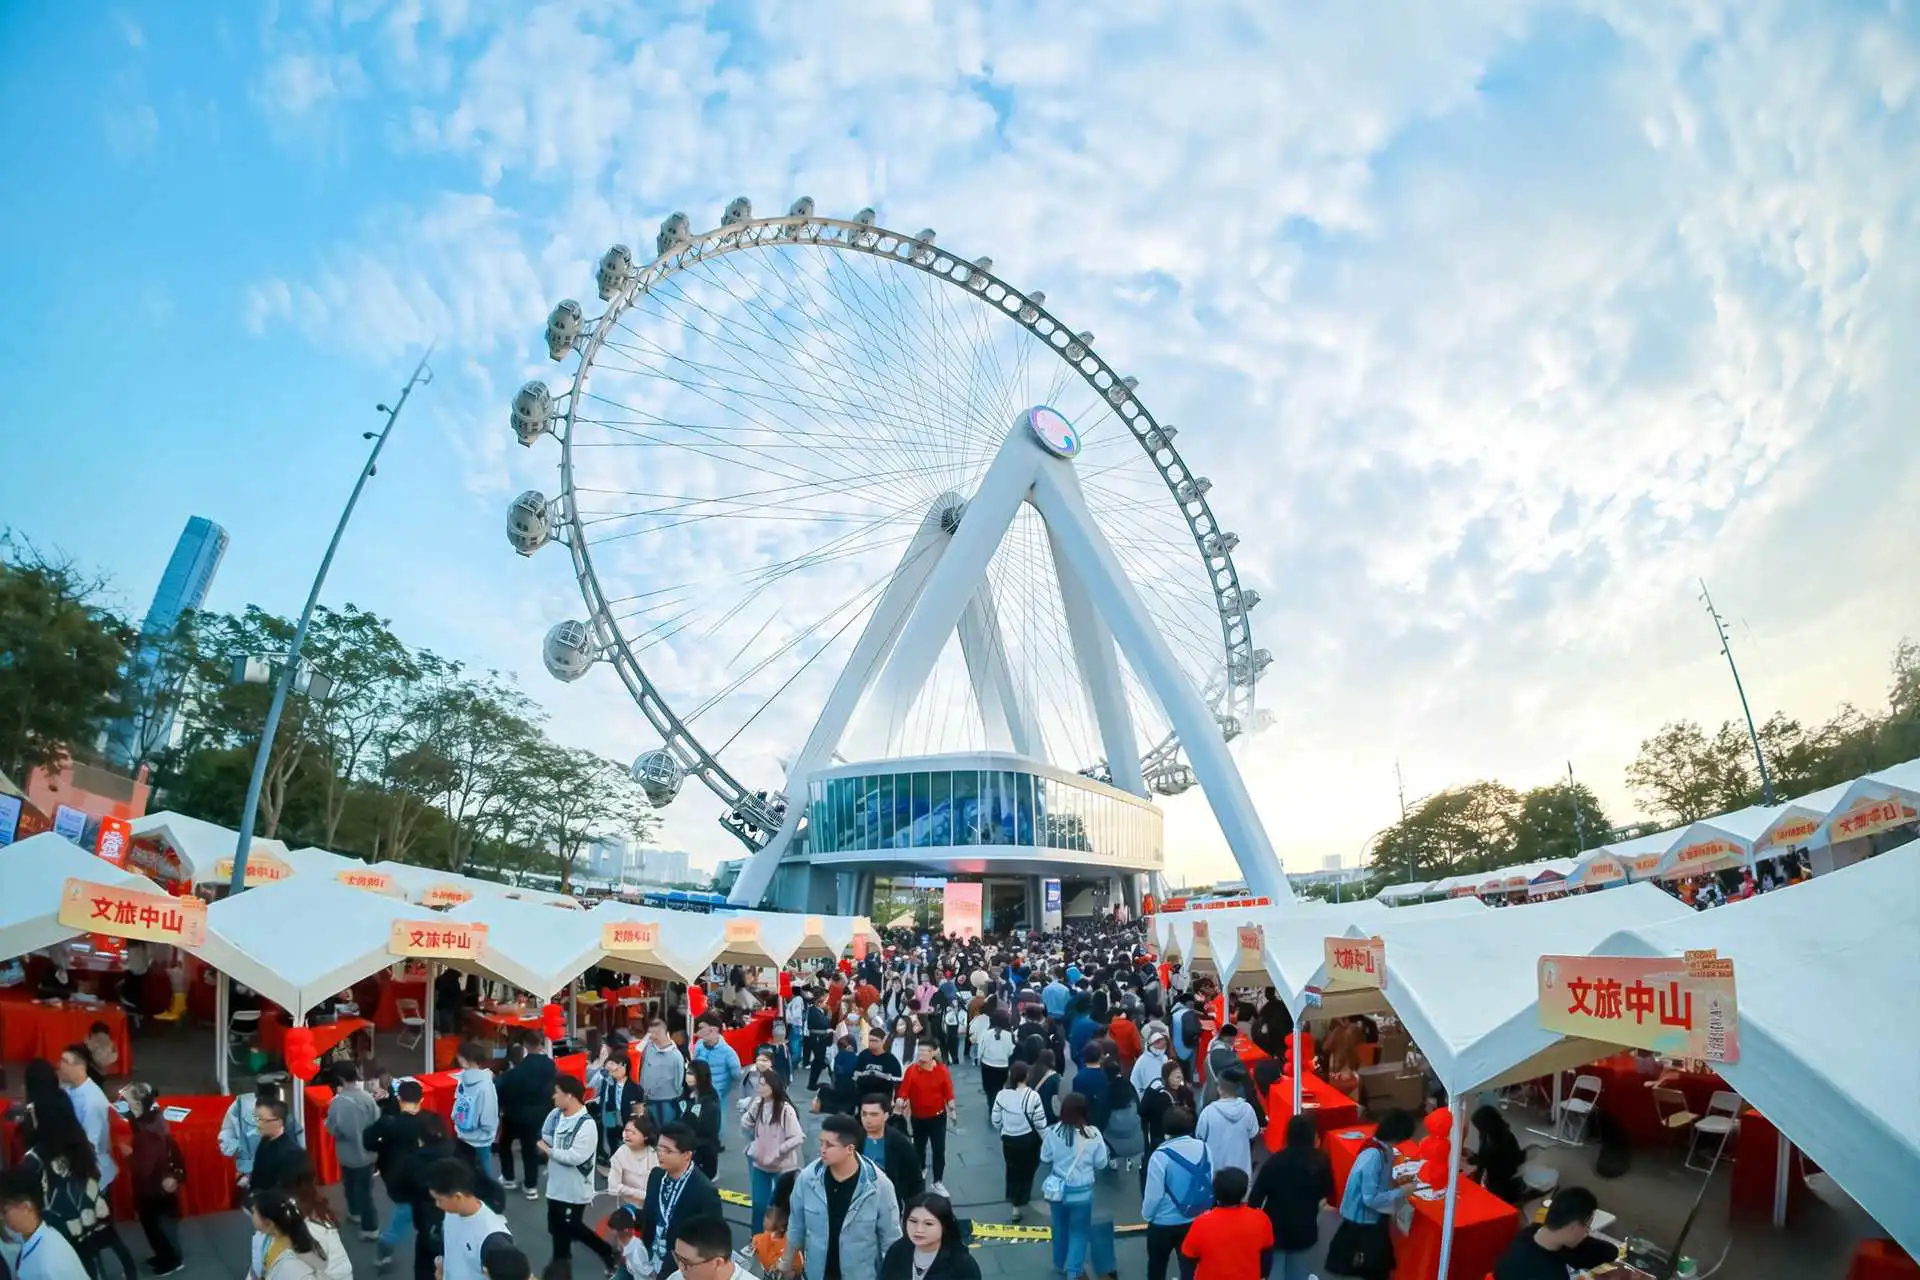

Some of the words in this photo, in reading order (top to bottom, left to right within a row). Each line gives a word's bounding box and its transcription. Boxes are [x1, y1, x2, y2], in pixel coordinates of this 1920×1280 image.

[90, 896, 184, 934] 文旅中山
[1567, 976, 1693, 1031] 文旅中山
